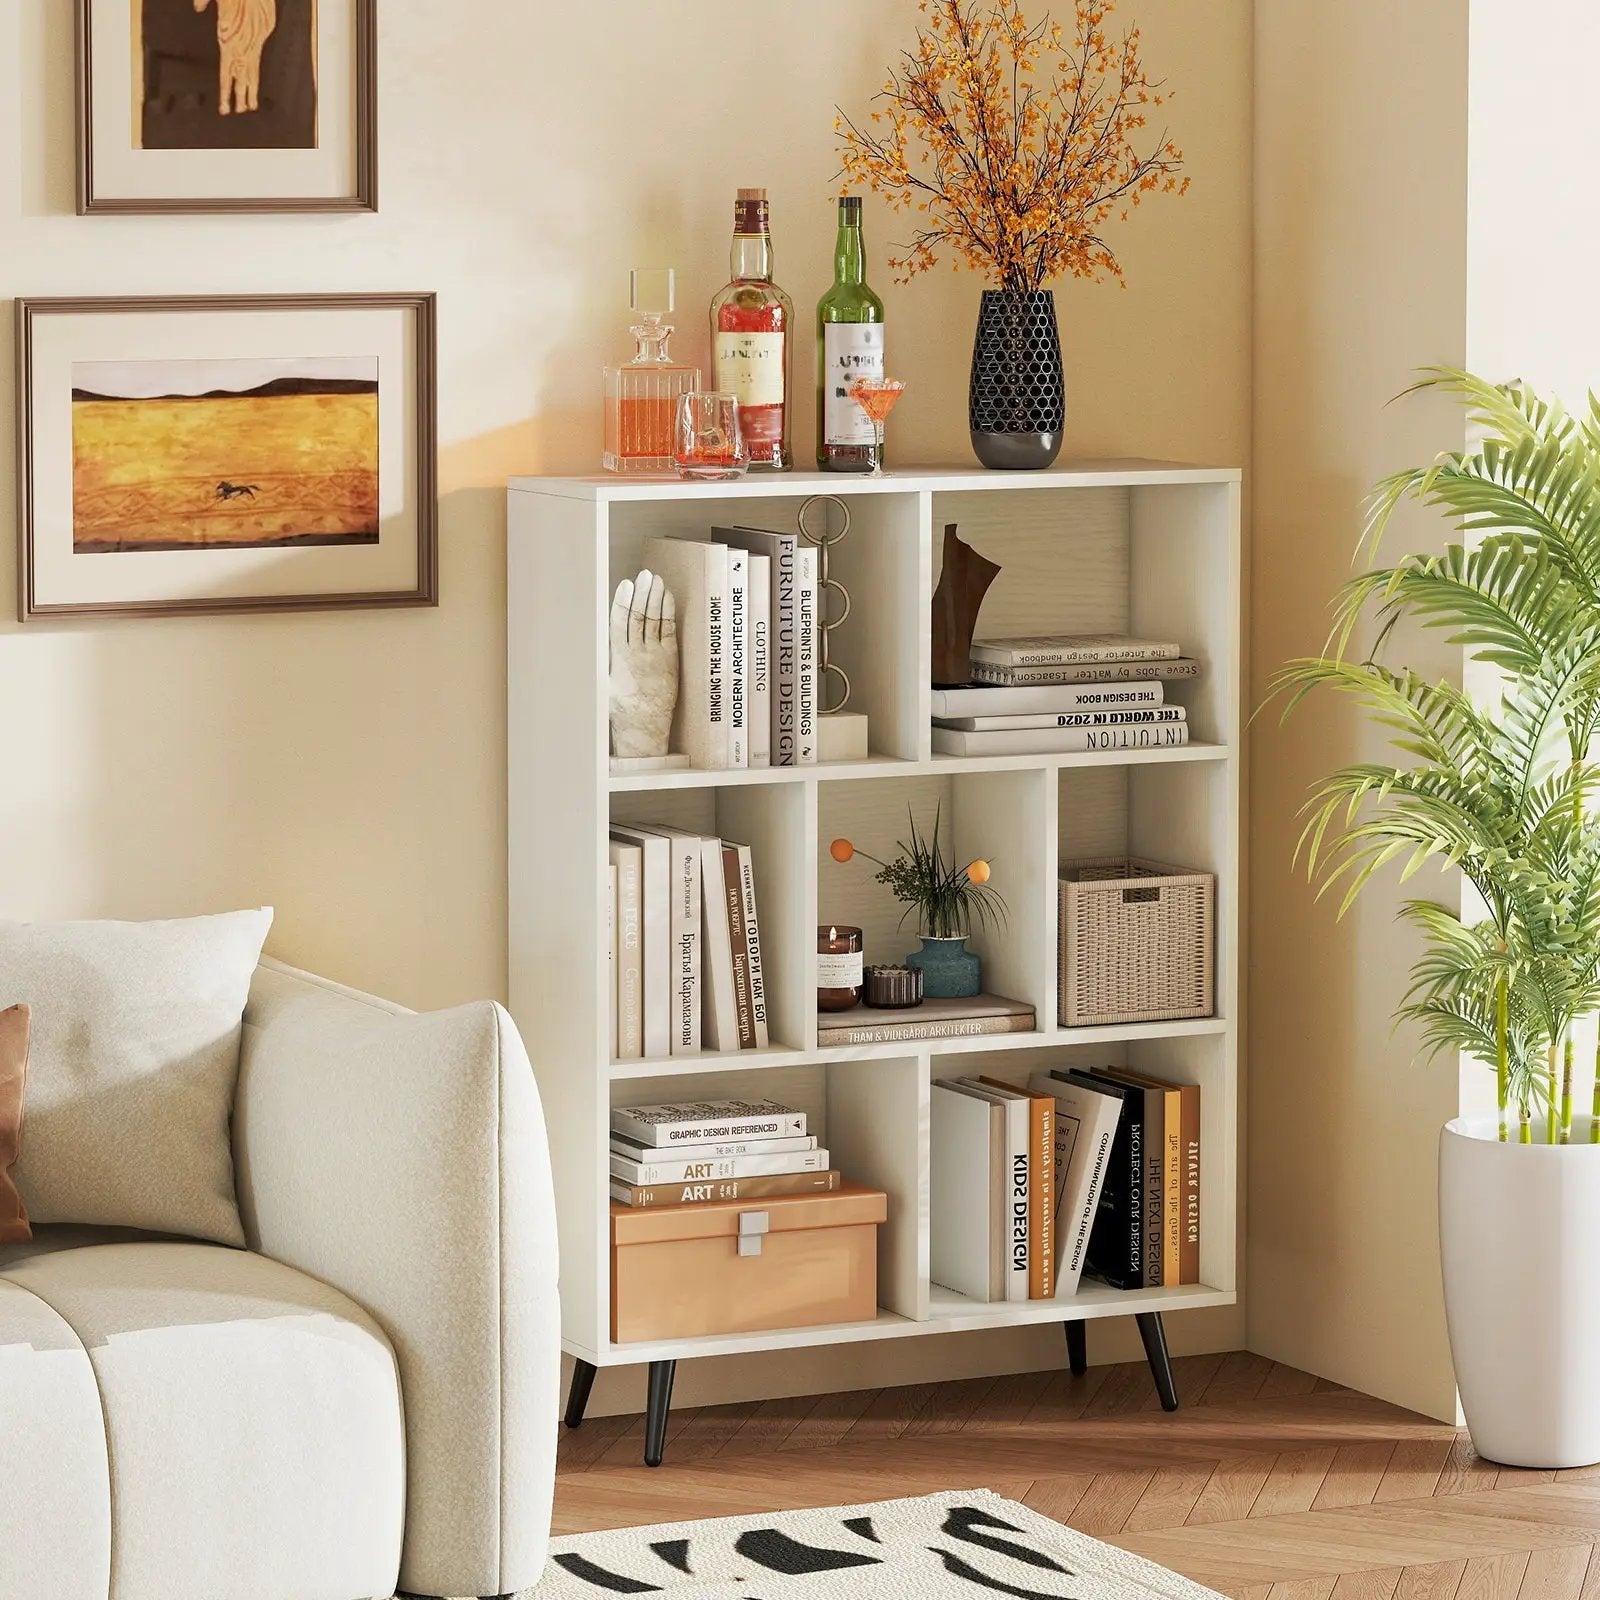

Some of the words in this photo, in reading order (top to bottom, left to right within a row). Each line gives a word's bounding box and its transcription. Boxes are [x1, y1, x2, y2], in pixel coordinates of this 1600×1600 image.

[710, 595, 722, 623] HOME
[779, 539, 794, 675] FURNITURE
[732, 586, 743, 676] ARCHITECTURE
[800, 589, 812, 661] BLUEPRINTS
[710, 624, 722, 654] HOUSE
[755, 621, 766, 693] CLOTHING
[1018, 652, 1062, 664] Handbook
[1066, 651, 1099, 662] Design
[1104, 649, 1146, 660] Interior
[1150, 648, 1167, 659] The
[710, 654, 722, 675] THE
[800, 663, 812, 672] &
[1074, 668, 1112, 679] Walter
[1117, 667, 1131, 677] by
[1135, 666, 1161, 676] Jobs
[1167, 665, 1198, 676] Steve
[1017, 670, 1068, 682] Isaacson
[710, 676, 722, 723] BRINGING
[732, 678, 743, 728] MODERN
[800, 674, 812, 736] BUILDINGS
[1075, 693, 1101, 705] BOOK
[1103, 692, 1136, 704] DESIGN
[1137, 691, 1155, 701] THE
[779, 682, 794, 767] DESIGN
[1056, 713, 1091, 726] 2020
[1093, 712, 1107, 724] IN
[1109, 710, 1155, 724] WORLD
[1157, 709, 1181, 721] THE
[1086, 727, 1183, 749] INTUITION
[678, 933, 695, 973] Братья
[746, 918, 761, 974] ГОВОРИ
[734, 953, 747, 1006] Бархатная
[753, 977, 764, 999] КАК
[678, 975, 695, 1046] Карамазовы
[755, 1004, 766, 1025] БОГ
[740, 1007, 751, 1041] смерть
[848, 1031, 873, 1044] THAM
[875, 1031, 882, 1042] &
[929, 1023, 982, 1038] ARKITEKTER
[669, 1128, 702, 1141] GRAPHIC
[703, 1126, 730, 1138] DESIGN
[731, 1122, 778, 1136] REFERENCED
[683, 1162, 714, 1180] ART
[681, 1184, 715, 1201] ART
